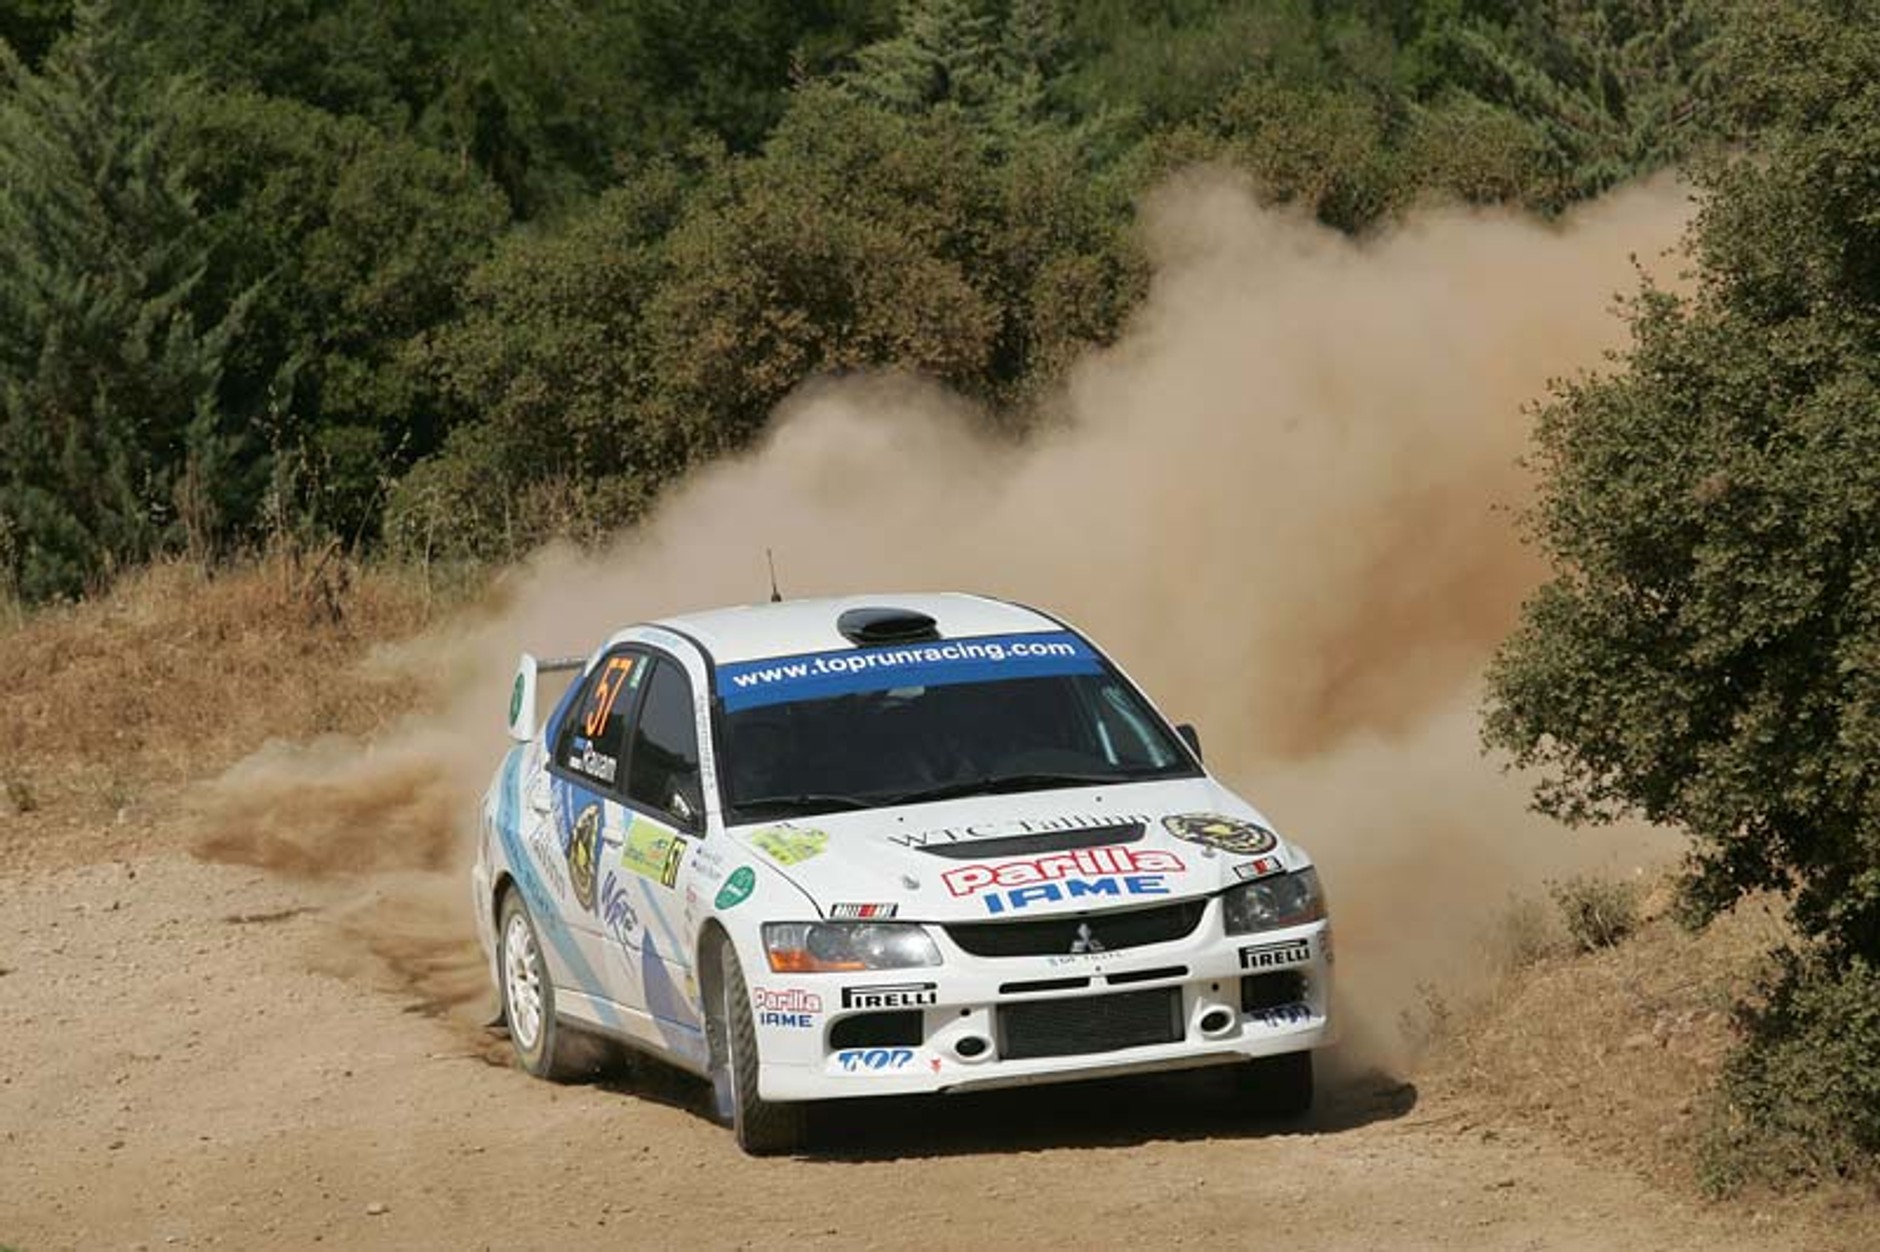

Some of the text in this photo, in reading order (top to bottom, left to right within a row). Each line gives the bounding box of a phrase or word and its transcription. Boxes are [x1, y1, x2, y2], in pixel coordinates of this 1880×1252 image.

[733, 640, 1075, 688] www.toprunracing.com
[585, 656, 633, 737] 57
[888, 824, 992, 847] WTC
[941, 845, 1185, 897] Parilla
[984, 875, 1171, 914] IAME
[1238, 937, 1310, 969] PIRELLI
[753, 987, 822, 1012] Parilla
[841, 982, 937, 1009] PIRELLI
[761, 1012, 813, 1028] IAME
